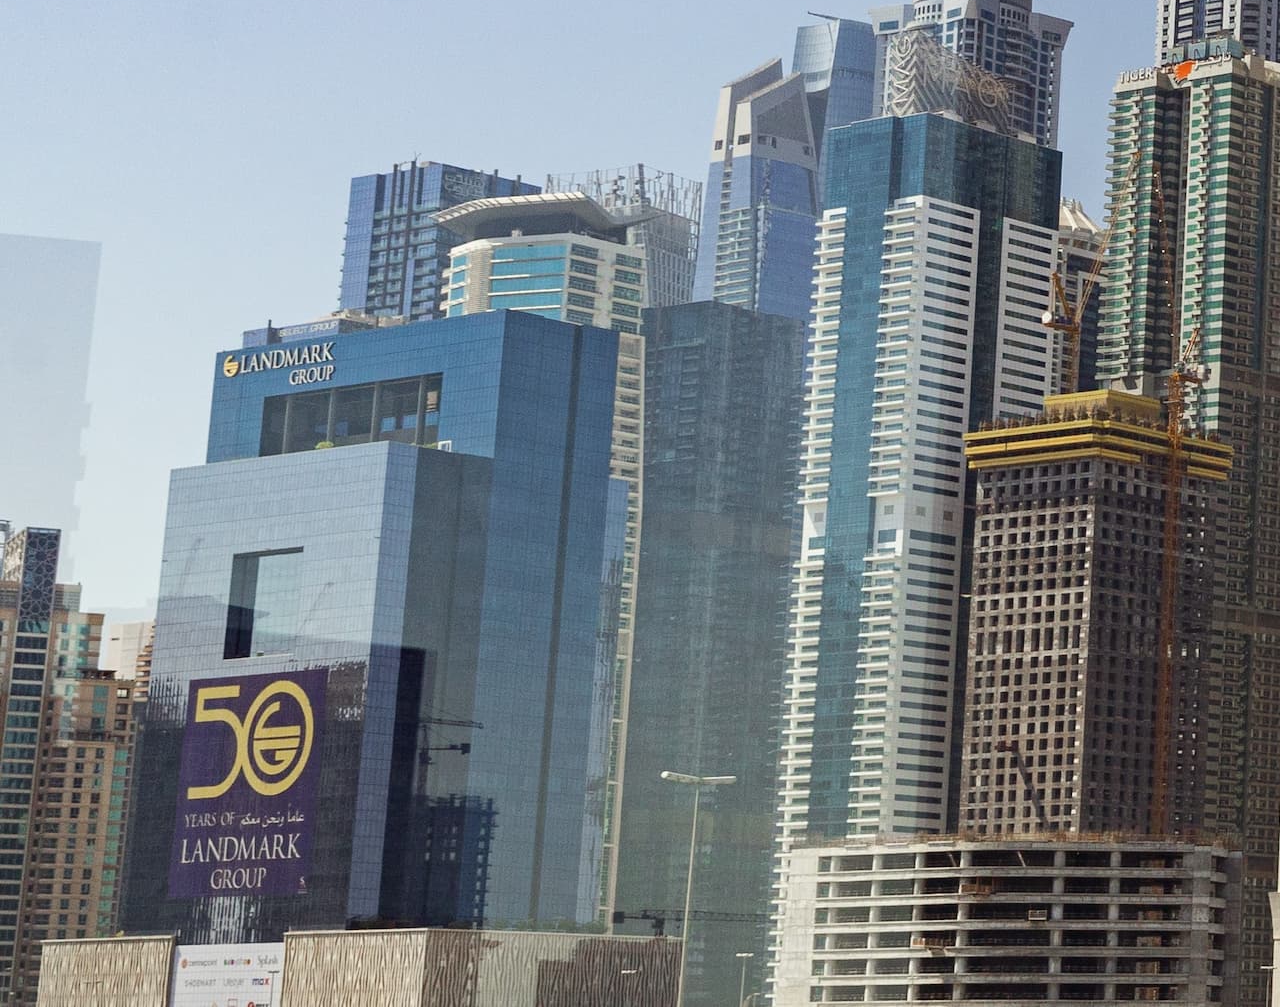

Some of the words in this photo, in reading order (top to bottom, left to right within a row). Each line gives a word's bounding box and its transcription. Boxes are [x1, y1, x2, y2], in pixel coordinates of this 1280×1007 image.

[1119, 66, 1153, 83] TIGER
[240, 341, 336, 374] LANDMARK
[288, 365, 335, 385] GROUP
[185, 812, 217, 827] YEARS
[220, 811, 236, 826] OF
[180, 832, 301, 864] LANDMARK
[210, 867, 267, 890] GROUP
[252, 978, 270, 986] max
